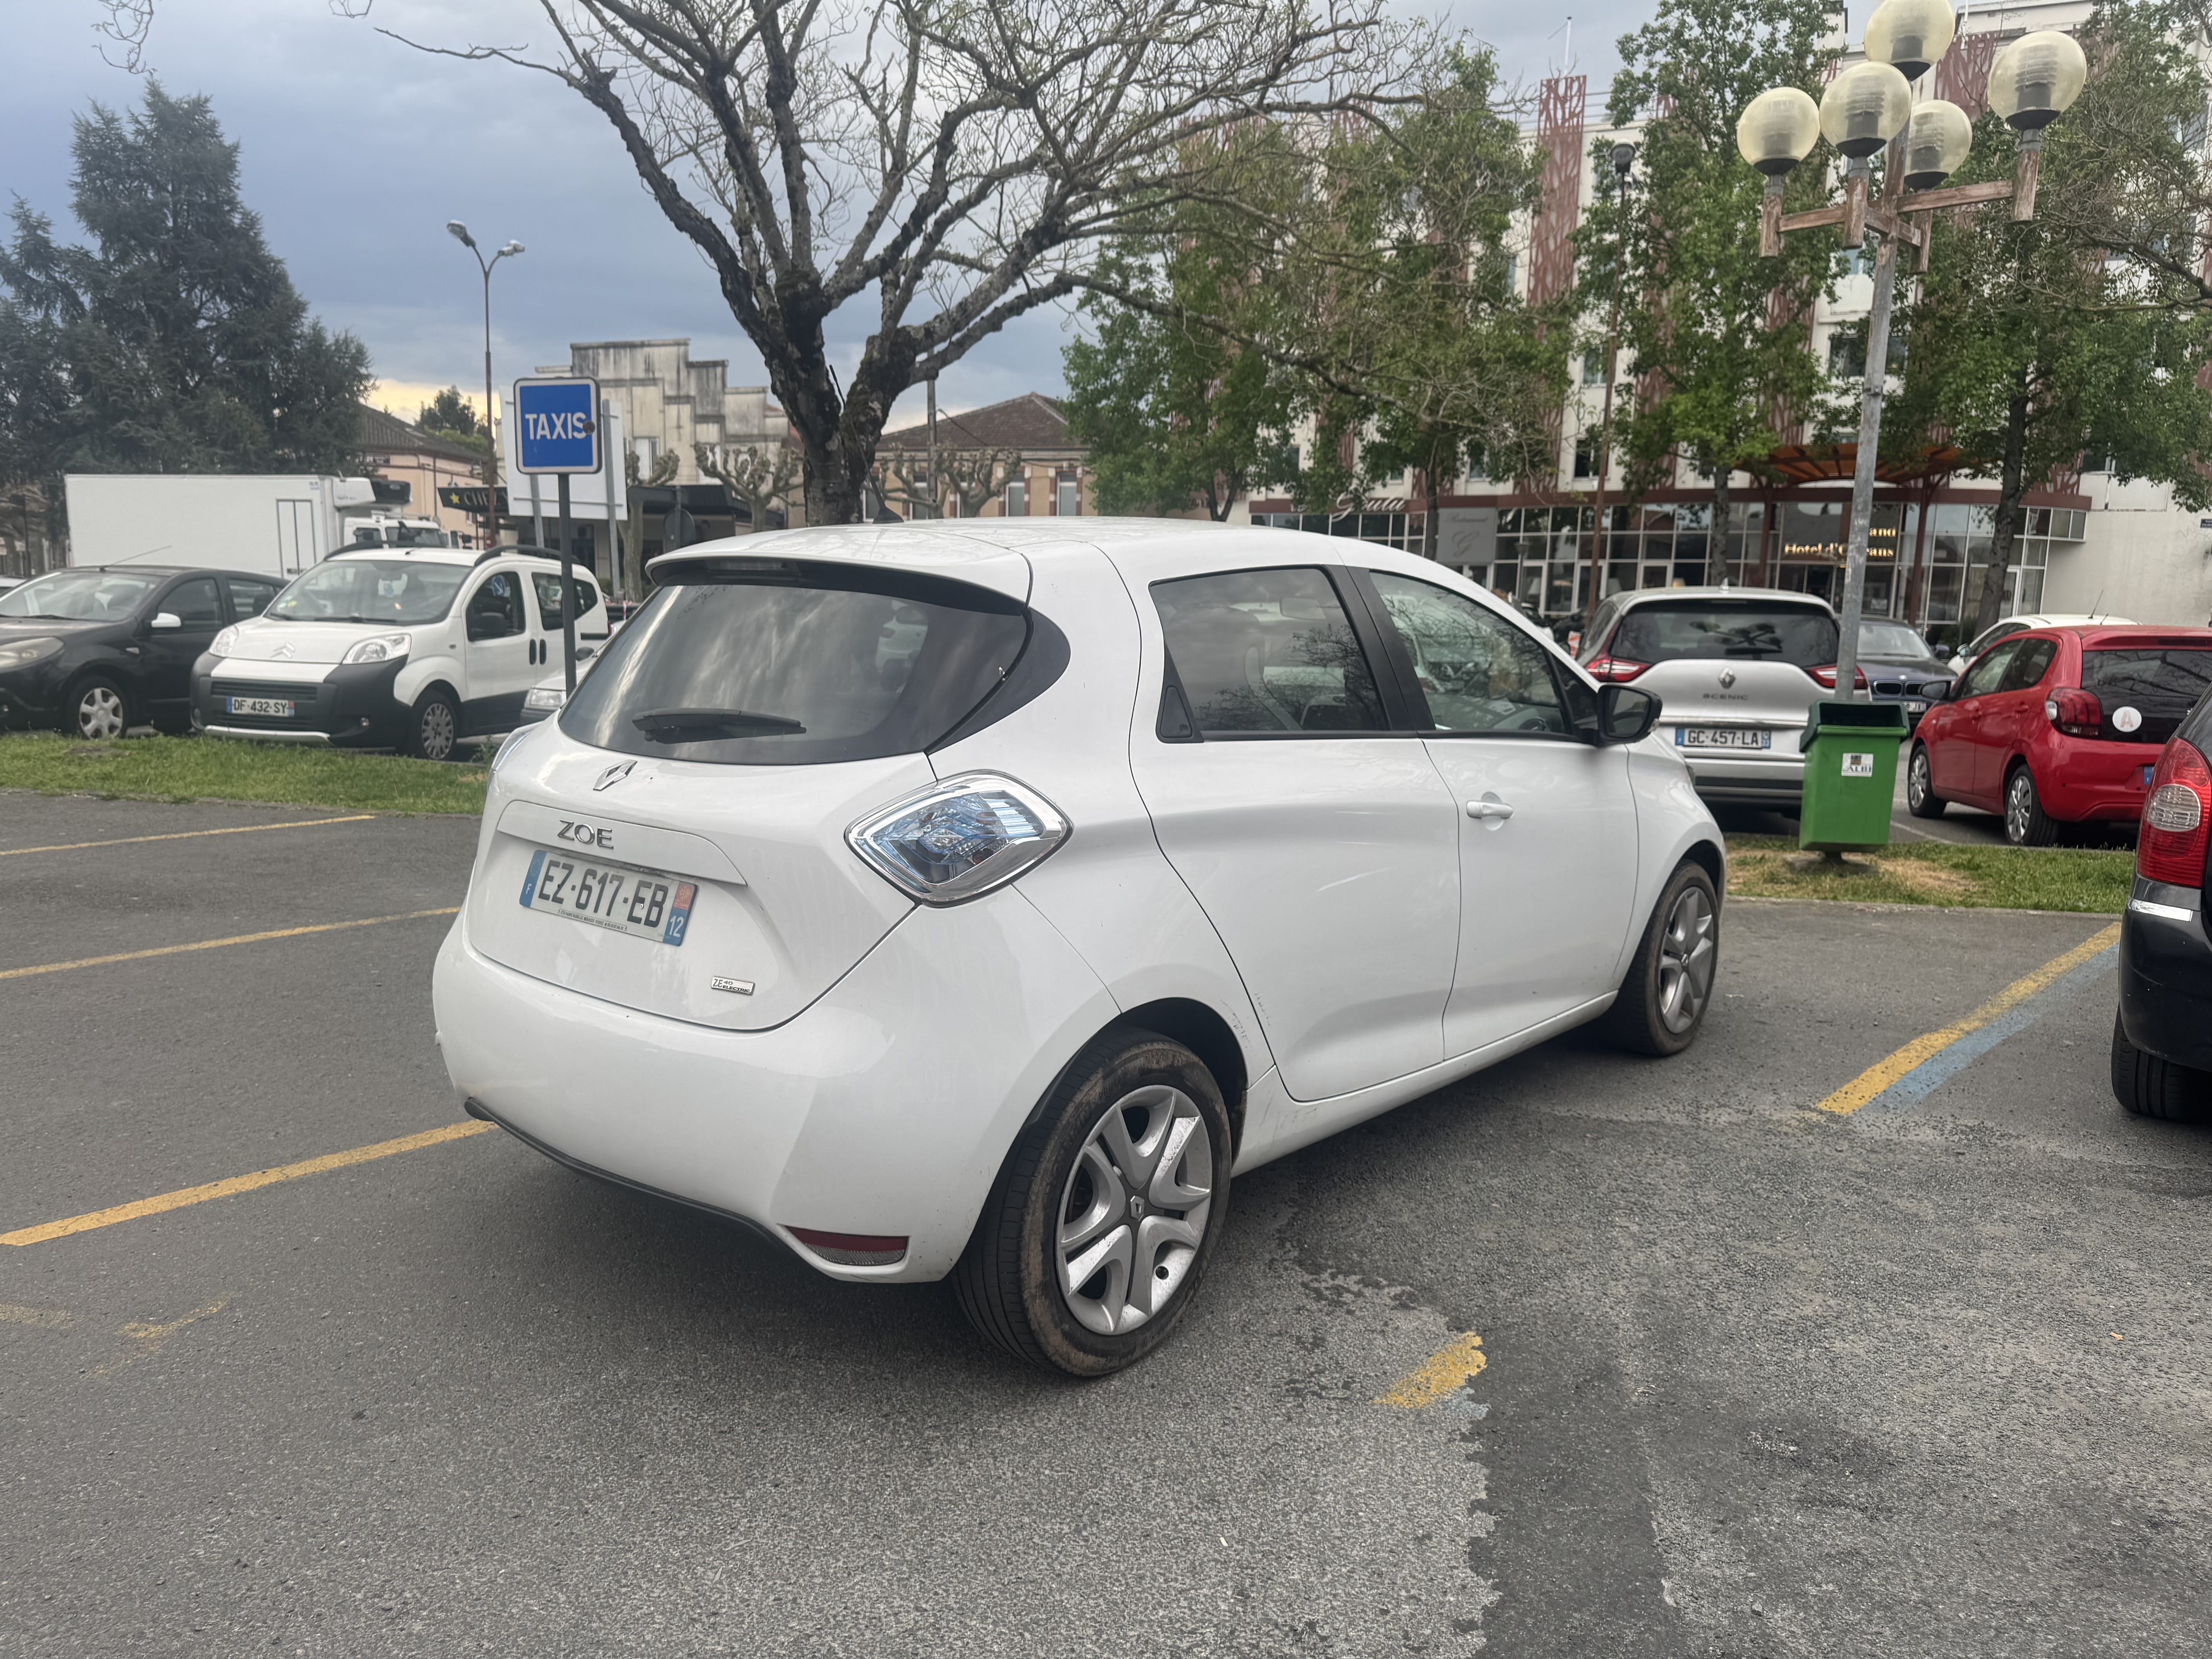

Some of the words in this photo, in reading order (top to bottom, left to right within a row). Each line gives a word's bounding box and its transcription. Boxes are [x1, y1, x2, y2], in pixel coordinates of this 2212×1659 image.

[525, 412, 587, 440] TAXIS
[1869, 526, 1896, 537] and
[2120, 710, 2133, 728] A
[557, 819, 615, 849] ZOE
[525, 883, 532, 895] F
[538, 859, 669, 928] EZ-617-EB
[669, 915, 684, 938] 12
[723, 985, 750, 993] ELECTRIC
